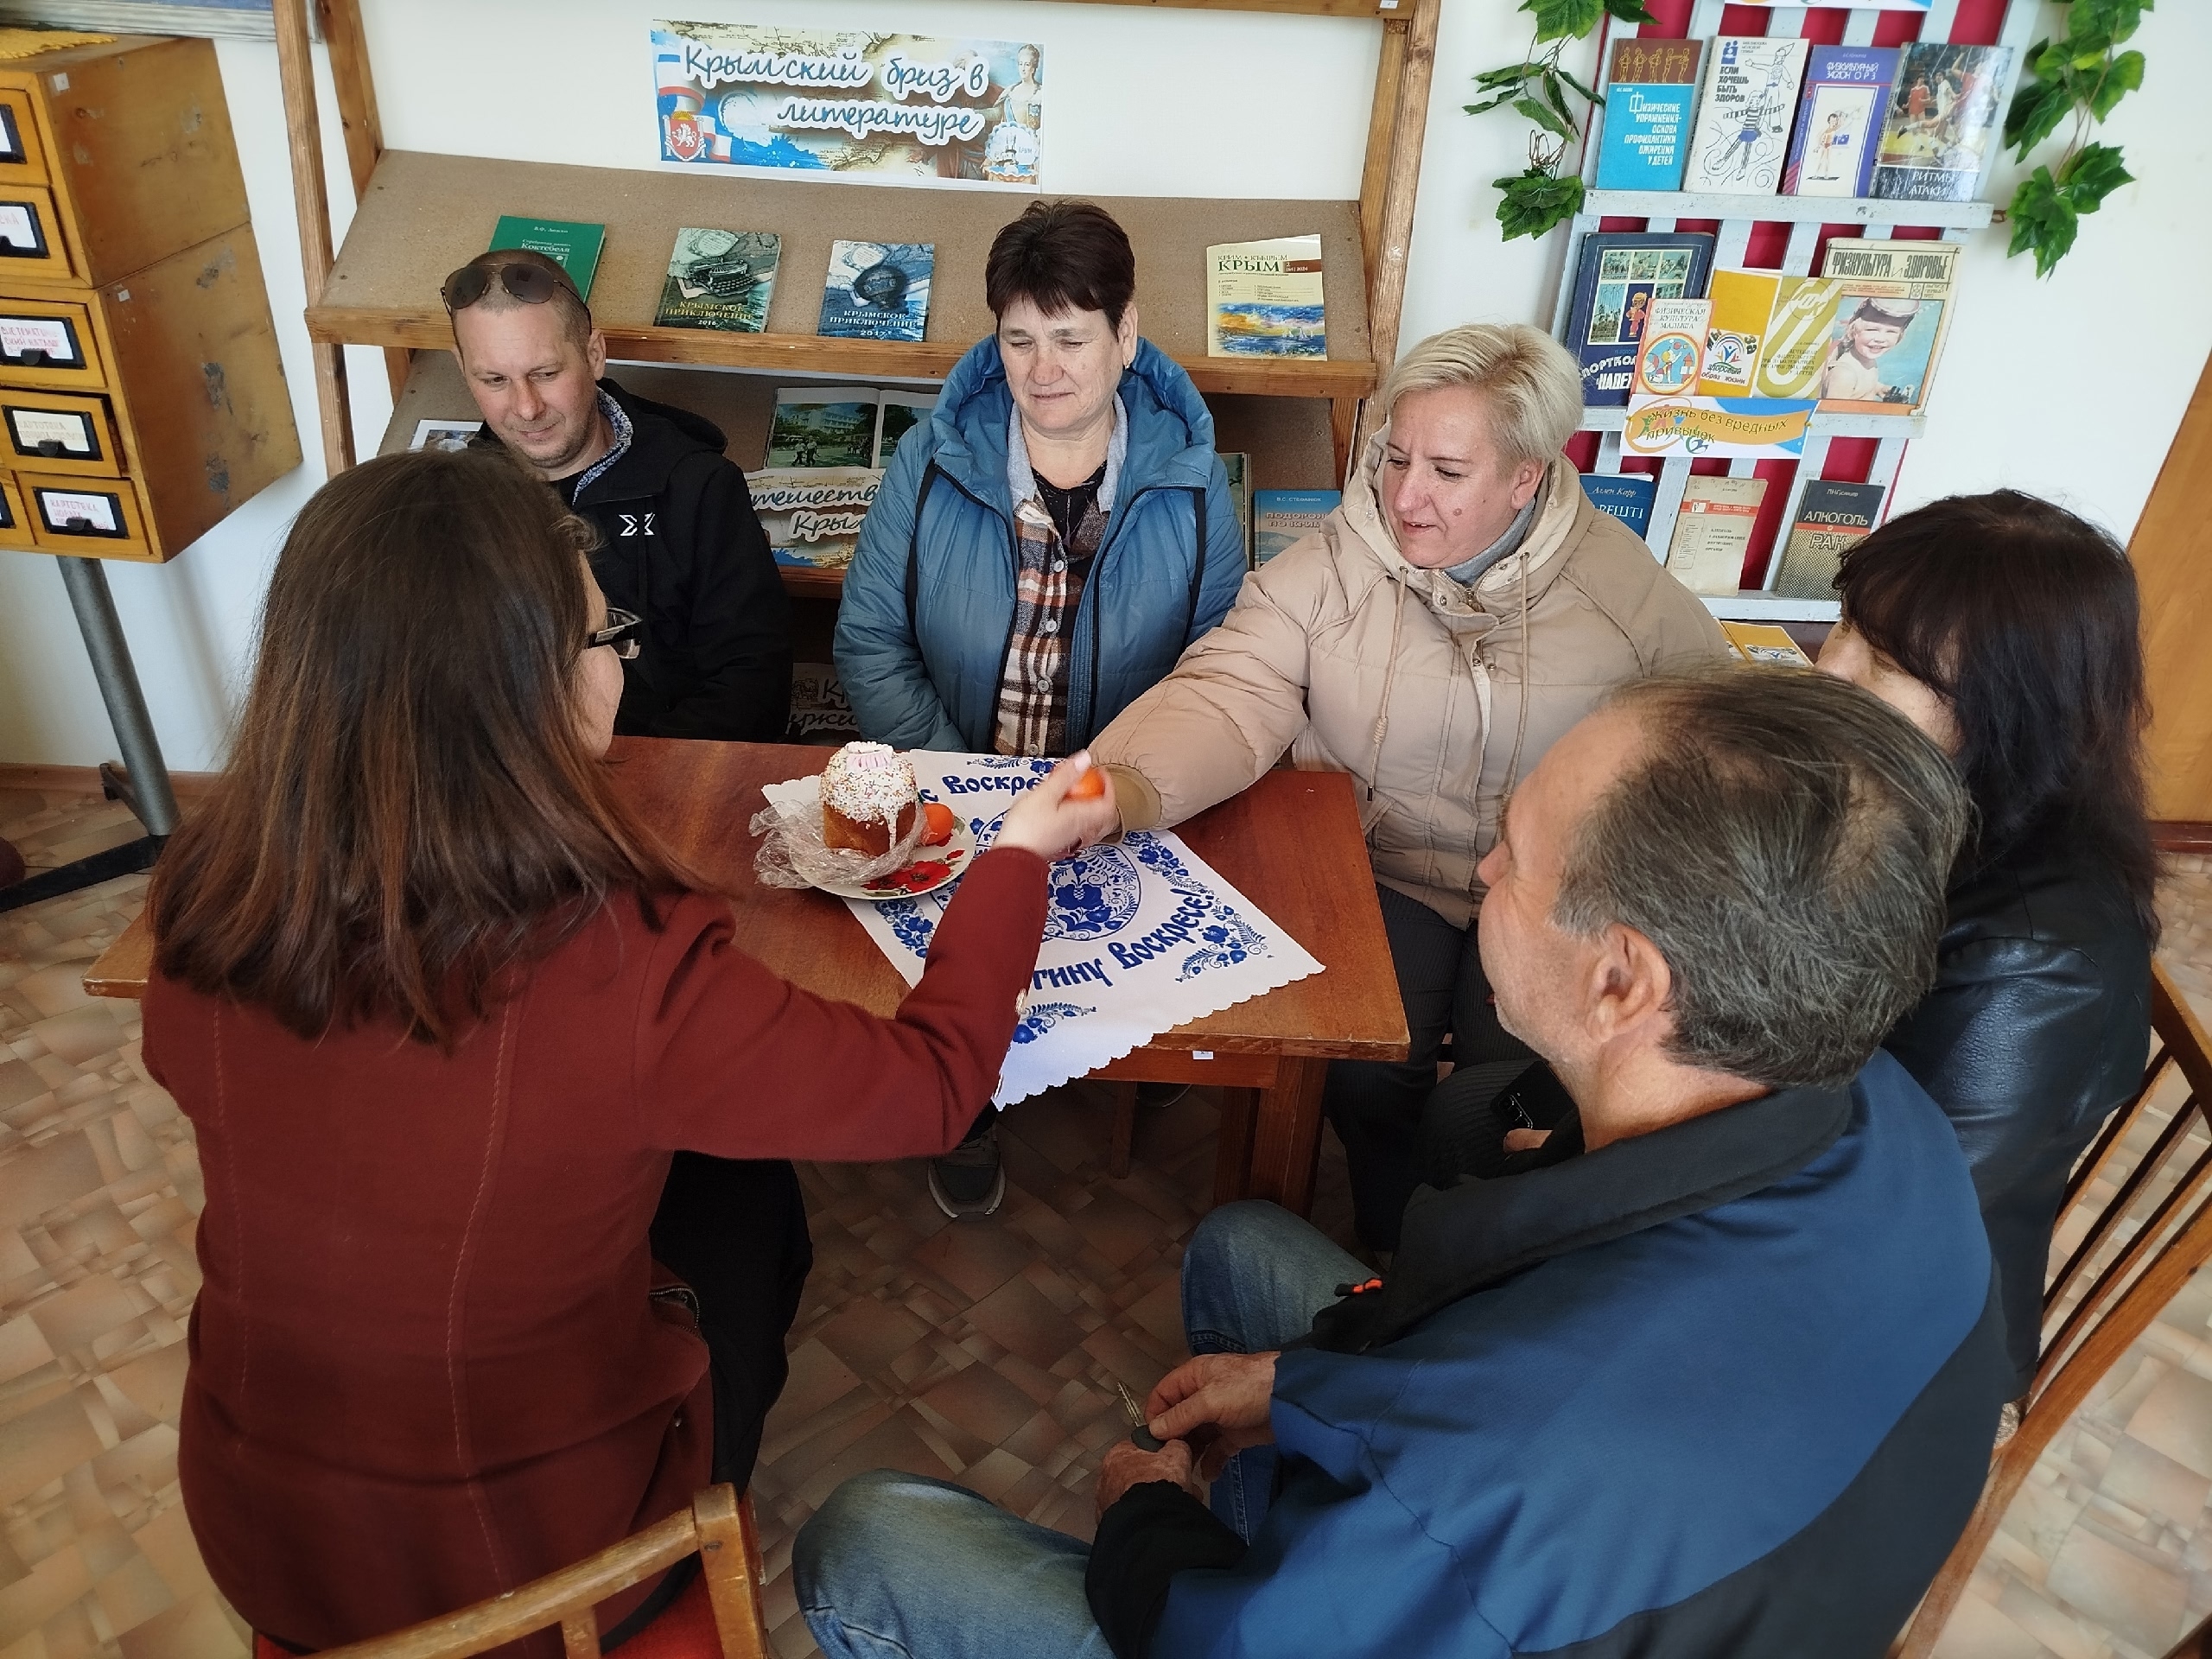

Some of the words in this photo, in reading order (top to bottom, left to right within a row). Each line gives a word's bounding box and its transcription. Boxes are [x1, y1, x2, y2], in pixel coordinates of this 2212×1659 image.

[685, 44, 868, 82] Крымский
[886, 57, 961, 96] бриз
[966, 63, 984, 93] в
[1719, 67, 1739, 75] ЕСЛИ
[1717, 75, 1750, 85] ХОЧЕШЬ
[1716, 85, 1738, 93] БЫТЬ
[1629, 92, 1681, 114] ФИЗИЧЕСКИЕ
[1714, 93, 1745, 103] ЗДОРОВ
[777, 101, 982, 141] литературе
[1651, 124, 1677, 134] ОСНОВА
[1624, 134, 1676, 144] ПРОФИЛАКТИКИ
[1638, 144, 1675, 156] ОЖИРЕНИЯ
[1647, 156, 1653, 165] У
[1651, 155, 1673, 166] ДЕТЕЙ
[1911, 171, 1955, 182] РИТМЫ
[1909, 185, 1948, 197] АТАКИ
[1218, 260, 1281, 272] КРЫМ
[1832, 251, 1892, 278] ФИЗКУЛЬТУРА
[1904, 254, 1949, 280] ЗДОРОВЬЕ
[679, 302, 745, 312] КРЫМСКОЕ
[1655, 307, 1706, 315] ФИЗИЧЕСКАЯ
[665, 308, 753, 320] ПРИКЛЮЧЕНИЕ
[843, 310, 906, 320] КРЫМСКОЕ
[830, 317, 918, 327] ПРИКЛЮЧЕНИЕ
[1701, 372, 1721, 380] образ
[1700, 410, 1722, 424] без
[1726, 418, 1789, 435] вредных
[1646, 425, 1715, 443] привычек
[1616, 487, 1637, 498] Карр
[1804, 511, 1868, 526] АЛКОГОЛЬ
[1808, 533, 1847, 551] РАК
[1108, 888, 1215, 969] Воскресе!
